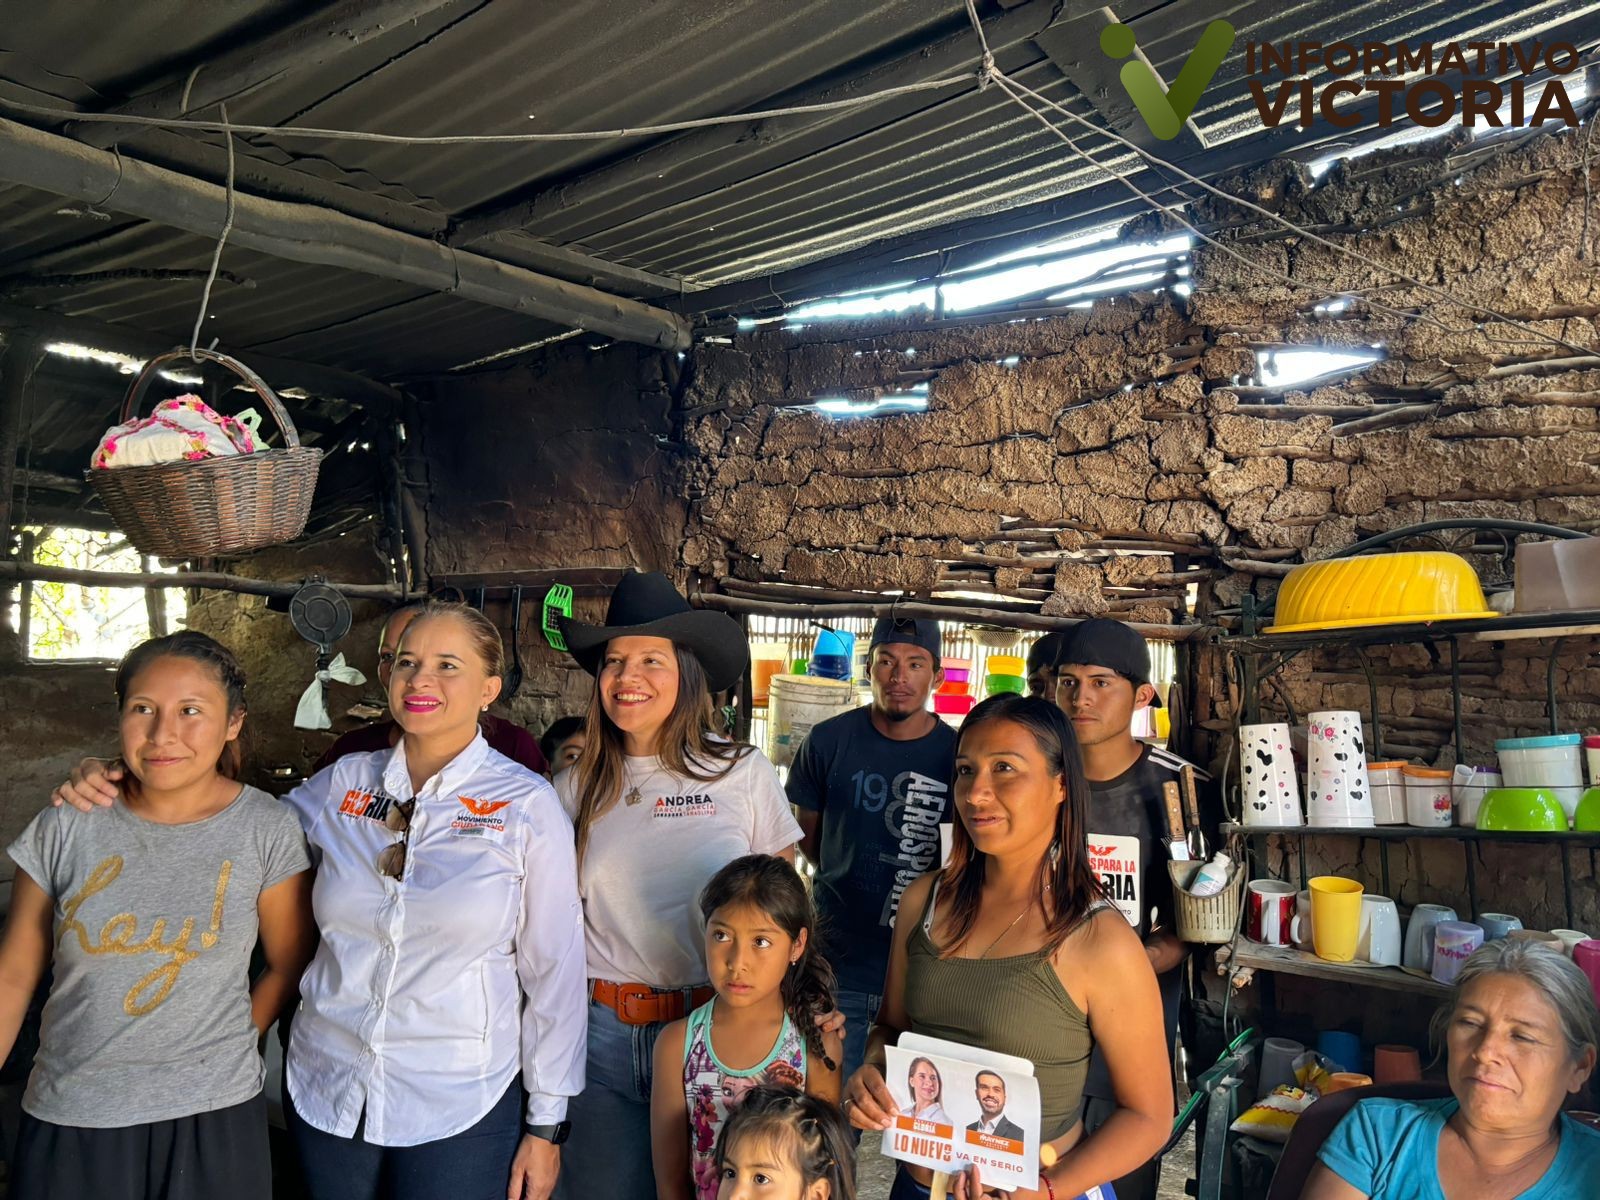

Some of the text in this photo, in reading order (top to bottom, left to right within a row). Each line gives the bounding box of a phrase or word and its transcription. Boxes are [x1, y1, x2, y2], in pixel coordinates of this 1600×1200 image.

[655, 794, 713, 807] ANDREA
[456, 815, 503, 825] MOVIMIENTO
[1098, 858, 1122, 873] PARA
[1125, 860, 1136, 873] LA
[56, 855, 233, 1016] hey!
[894, 1132, 953, 1162] LO NUEVO
[955, 1151, 1024, 1173] VA EN SERIO
